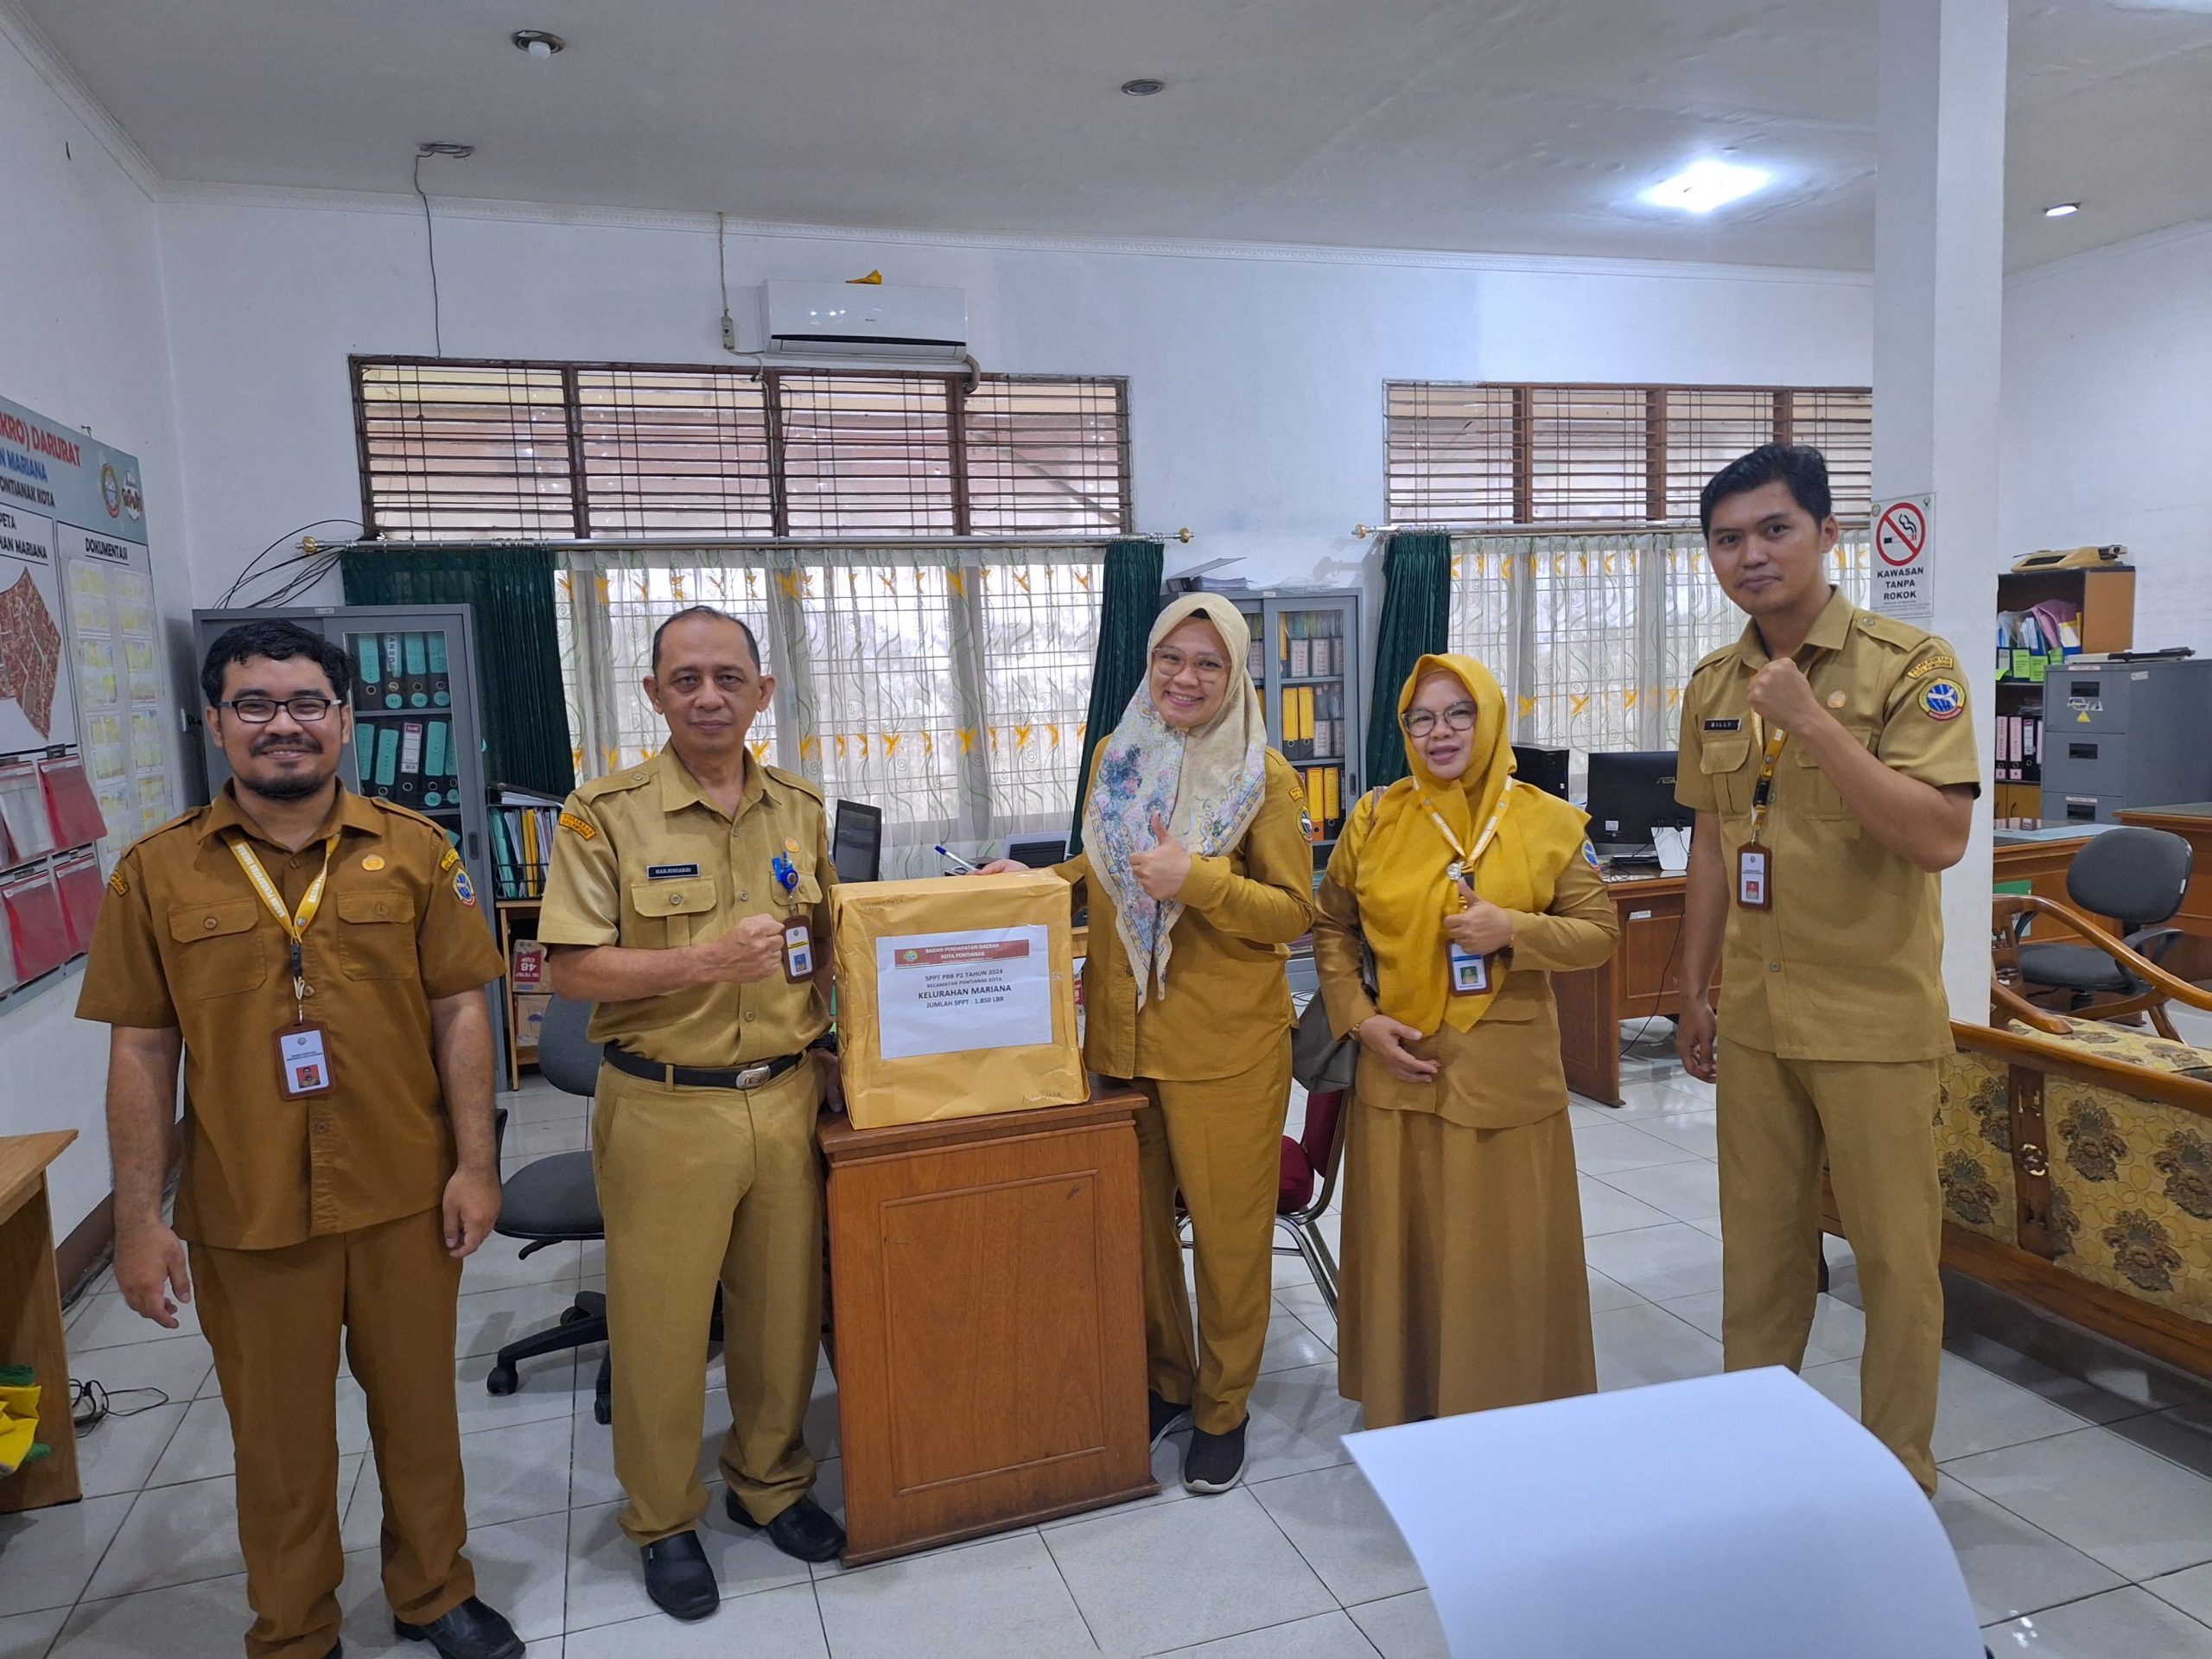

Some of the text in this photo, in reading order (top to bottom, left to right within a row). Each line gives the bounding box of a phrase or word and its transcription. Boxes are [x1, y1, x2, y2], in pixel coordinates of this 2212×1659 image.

[31, 424, 80, 467] DARURAT
[7, 448, 48, 483] MARIANA
[36, 486, 55, 508] KOTA
[15, 538, 48, 560] MARIANA
[86, 537, 128, 561] DOKUMENTASI
[1877, 566, 1924, 579] KAWASAN
[1885, 579, 1916, 589] TANPA
[1884, 590, 1917, 601] ROKOK
[1656, 776, 1677, 785] ASU
[520, 963, 537, 971] 48
[918, 984, 1012, 999] KELURAHAN MARIANA
